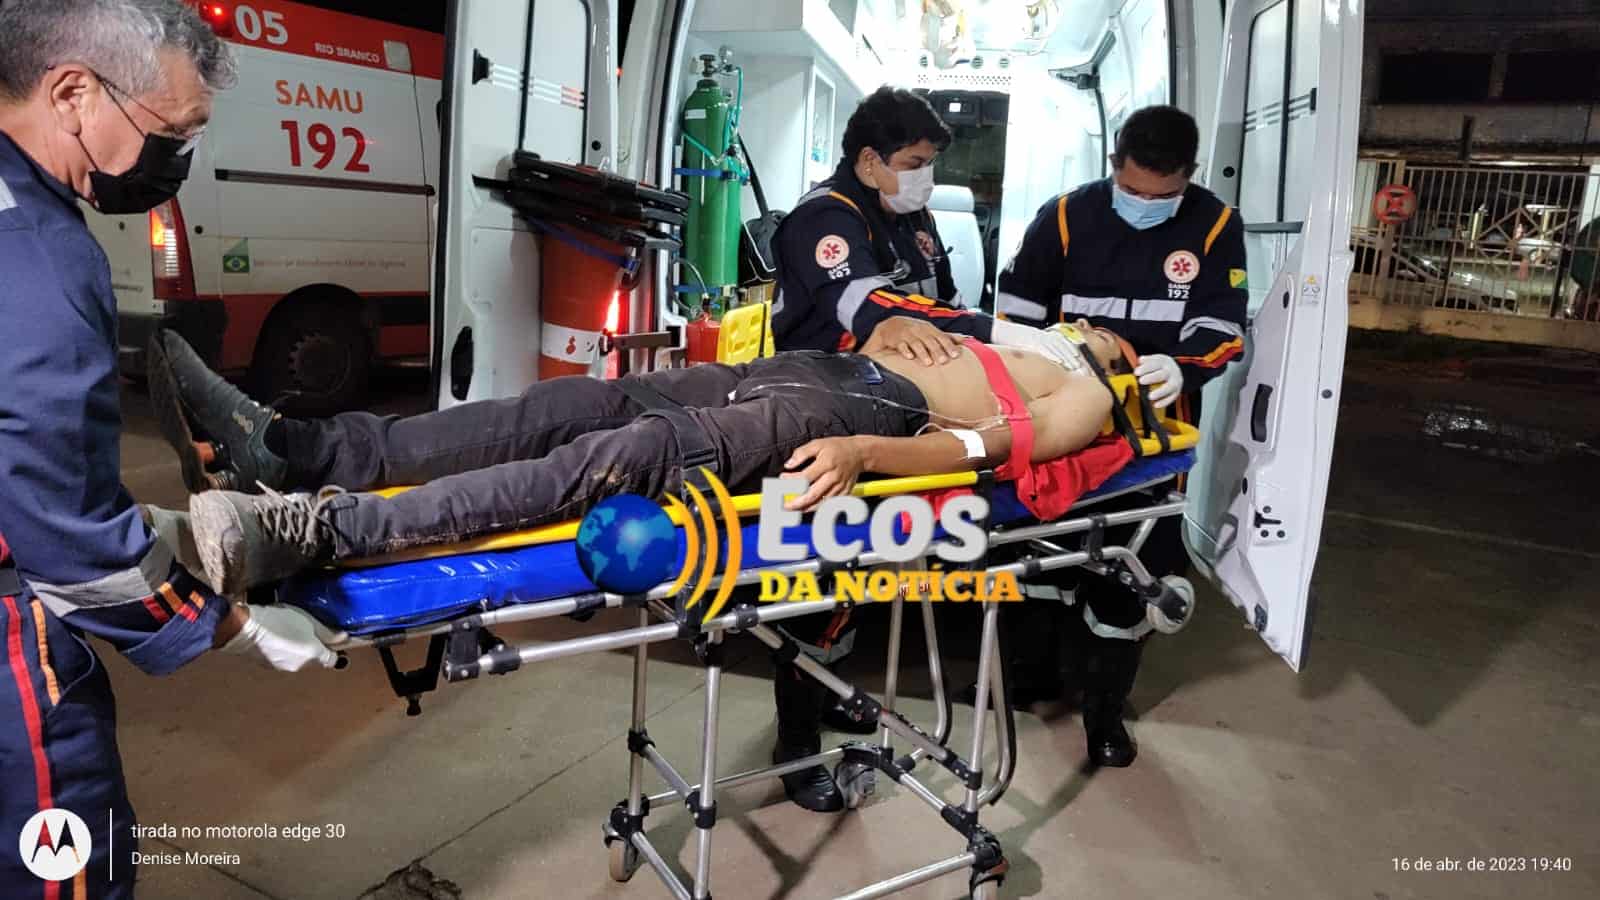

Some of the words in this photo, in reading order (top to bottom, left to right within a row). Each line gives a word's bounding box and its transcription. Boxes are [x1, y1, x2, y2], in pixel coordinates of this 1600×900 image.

[235, 5, 288, 45] 05
[314, 42, 335, 55] RIO
[336, 47, 380, 63] BRANCO
[275, 79, 364, 114] SAMU
[281, 120, 370, 173] 192
[1167, 289, 1190, 299] 192
